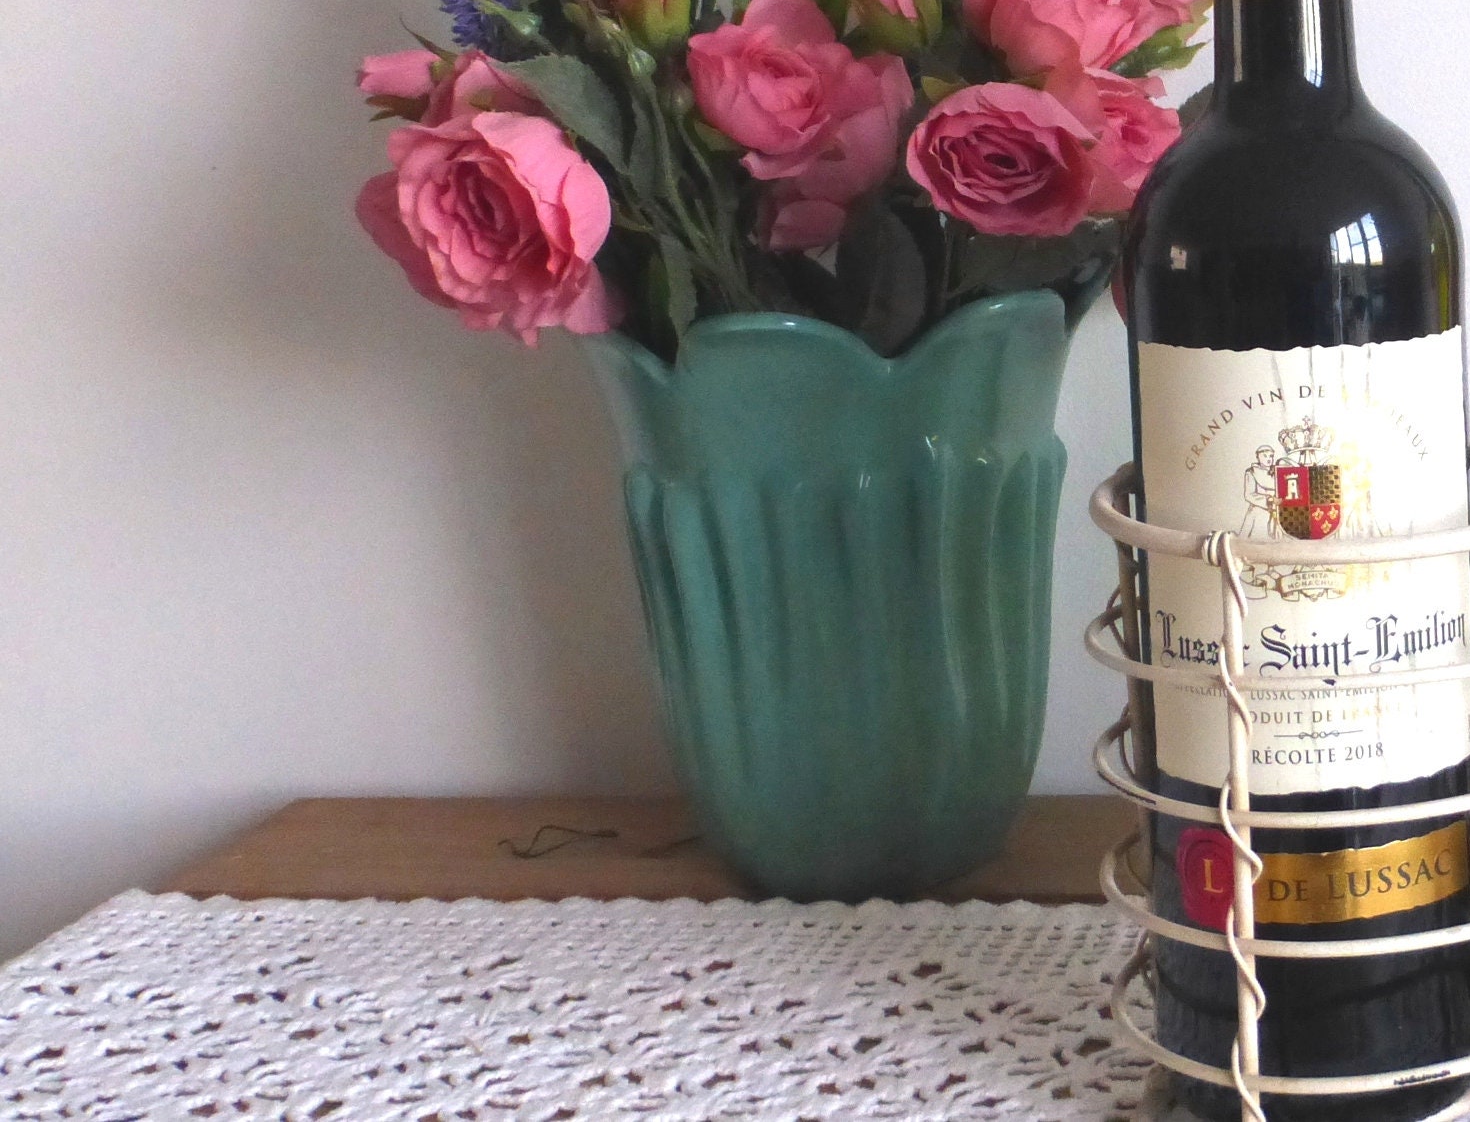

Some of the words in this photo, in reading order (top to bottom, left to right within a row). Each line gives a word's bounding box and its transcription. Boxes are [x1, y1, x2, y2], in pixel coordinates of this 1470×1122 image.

[1184, 409, 1234, 472] GRAND
[1241, 387, 1284, 410] VIN
[1299, 384, 1326, 399] DE
[1312, 709, 1332, 724] DE
[1251, 745, 1336, 766] RÉCOLTE
[1344, 741, 1384, 762] 2018
[1203, 858, 1224, 894] L
[1268, 879, 1307, 902] DE
[1327, 846, 1454, 900] LUSSAC
